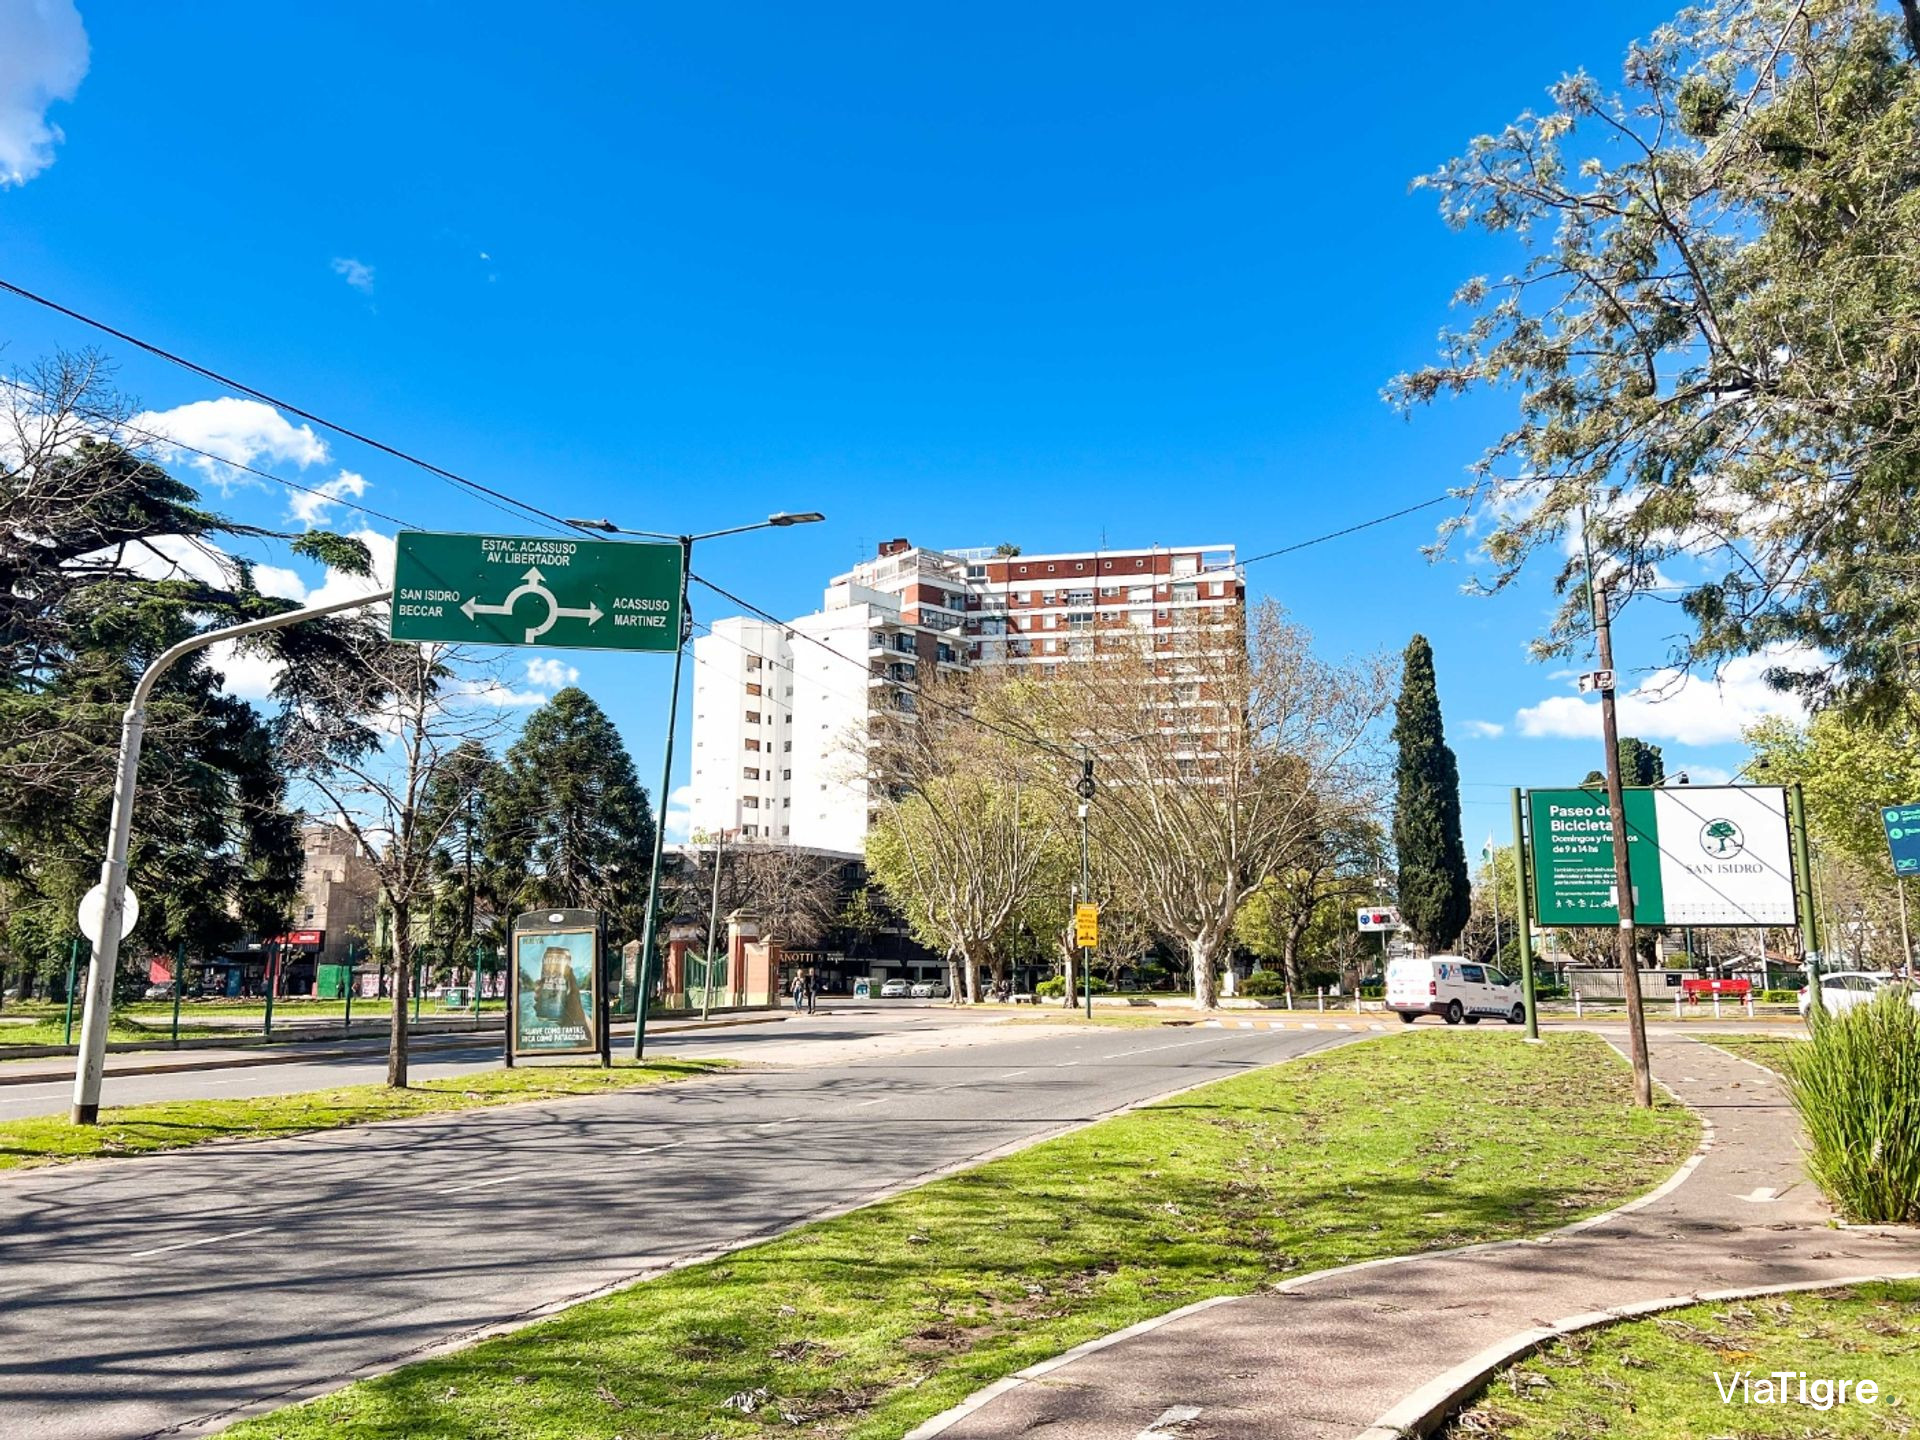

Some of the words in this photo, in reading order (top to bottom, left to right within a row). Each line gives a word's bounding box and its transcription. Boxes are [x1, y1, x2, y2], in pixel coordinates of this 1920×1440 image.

[482, 539, 518, 552] ESTAC.
[520, 541, 577, 554] ACASSUSO
[487, 551, 502, 563] AV.
[505, 552, 570, 566] LIBERTADOR
[400, 588, 422, 600] SAN
[424, 590, 460, 602] ISIDRO
[399, 604, 443, 617] BECCAR
[612, 597, 670, 612] ACASSUSO
[614, 614, 667, 628] MARTINEZ
[1549, 805, 1593, 817] Paseo
[1551, 834, 1595, 844] Domingos
[1552, 845, 1564, 853] de
[1565, 845, 1571, 853] 9
[1578, 845, 1588, 853] 14
[1686, 863, 1713, 874] SAN
[1717, 863, 1763, 874] ISIDRO
